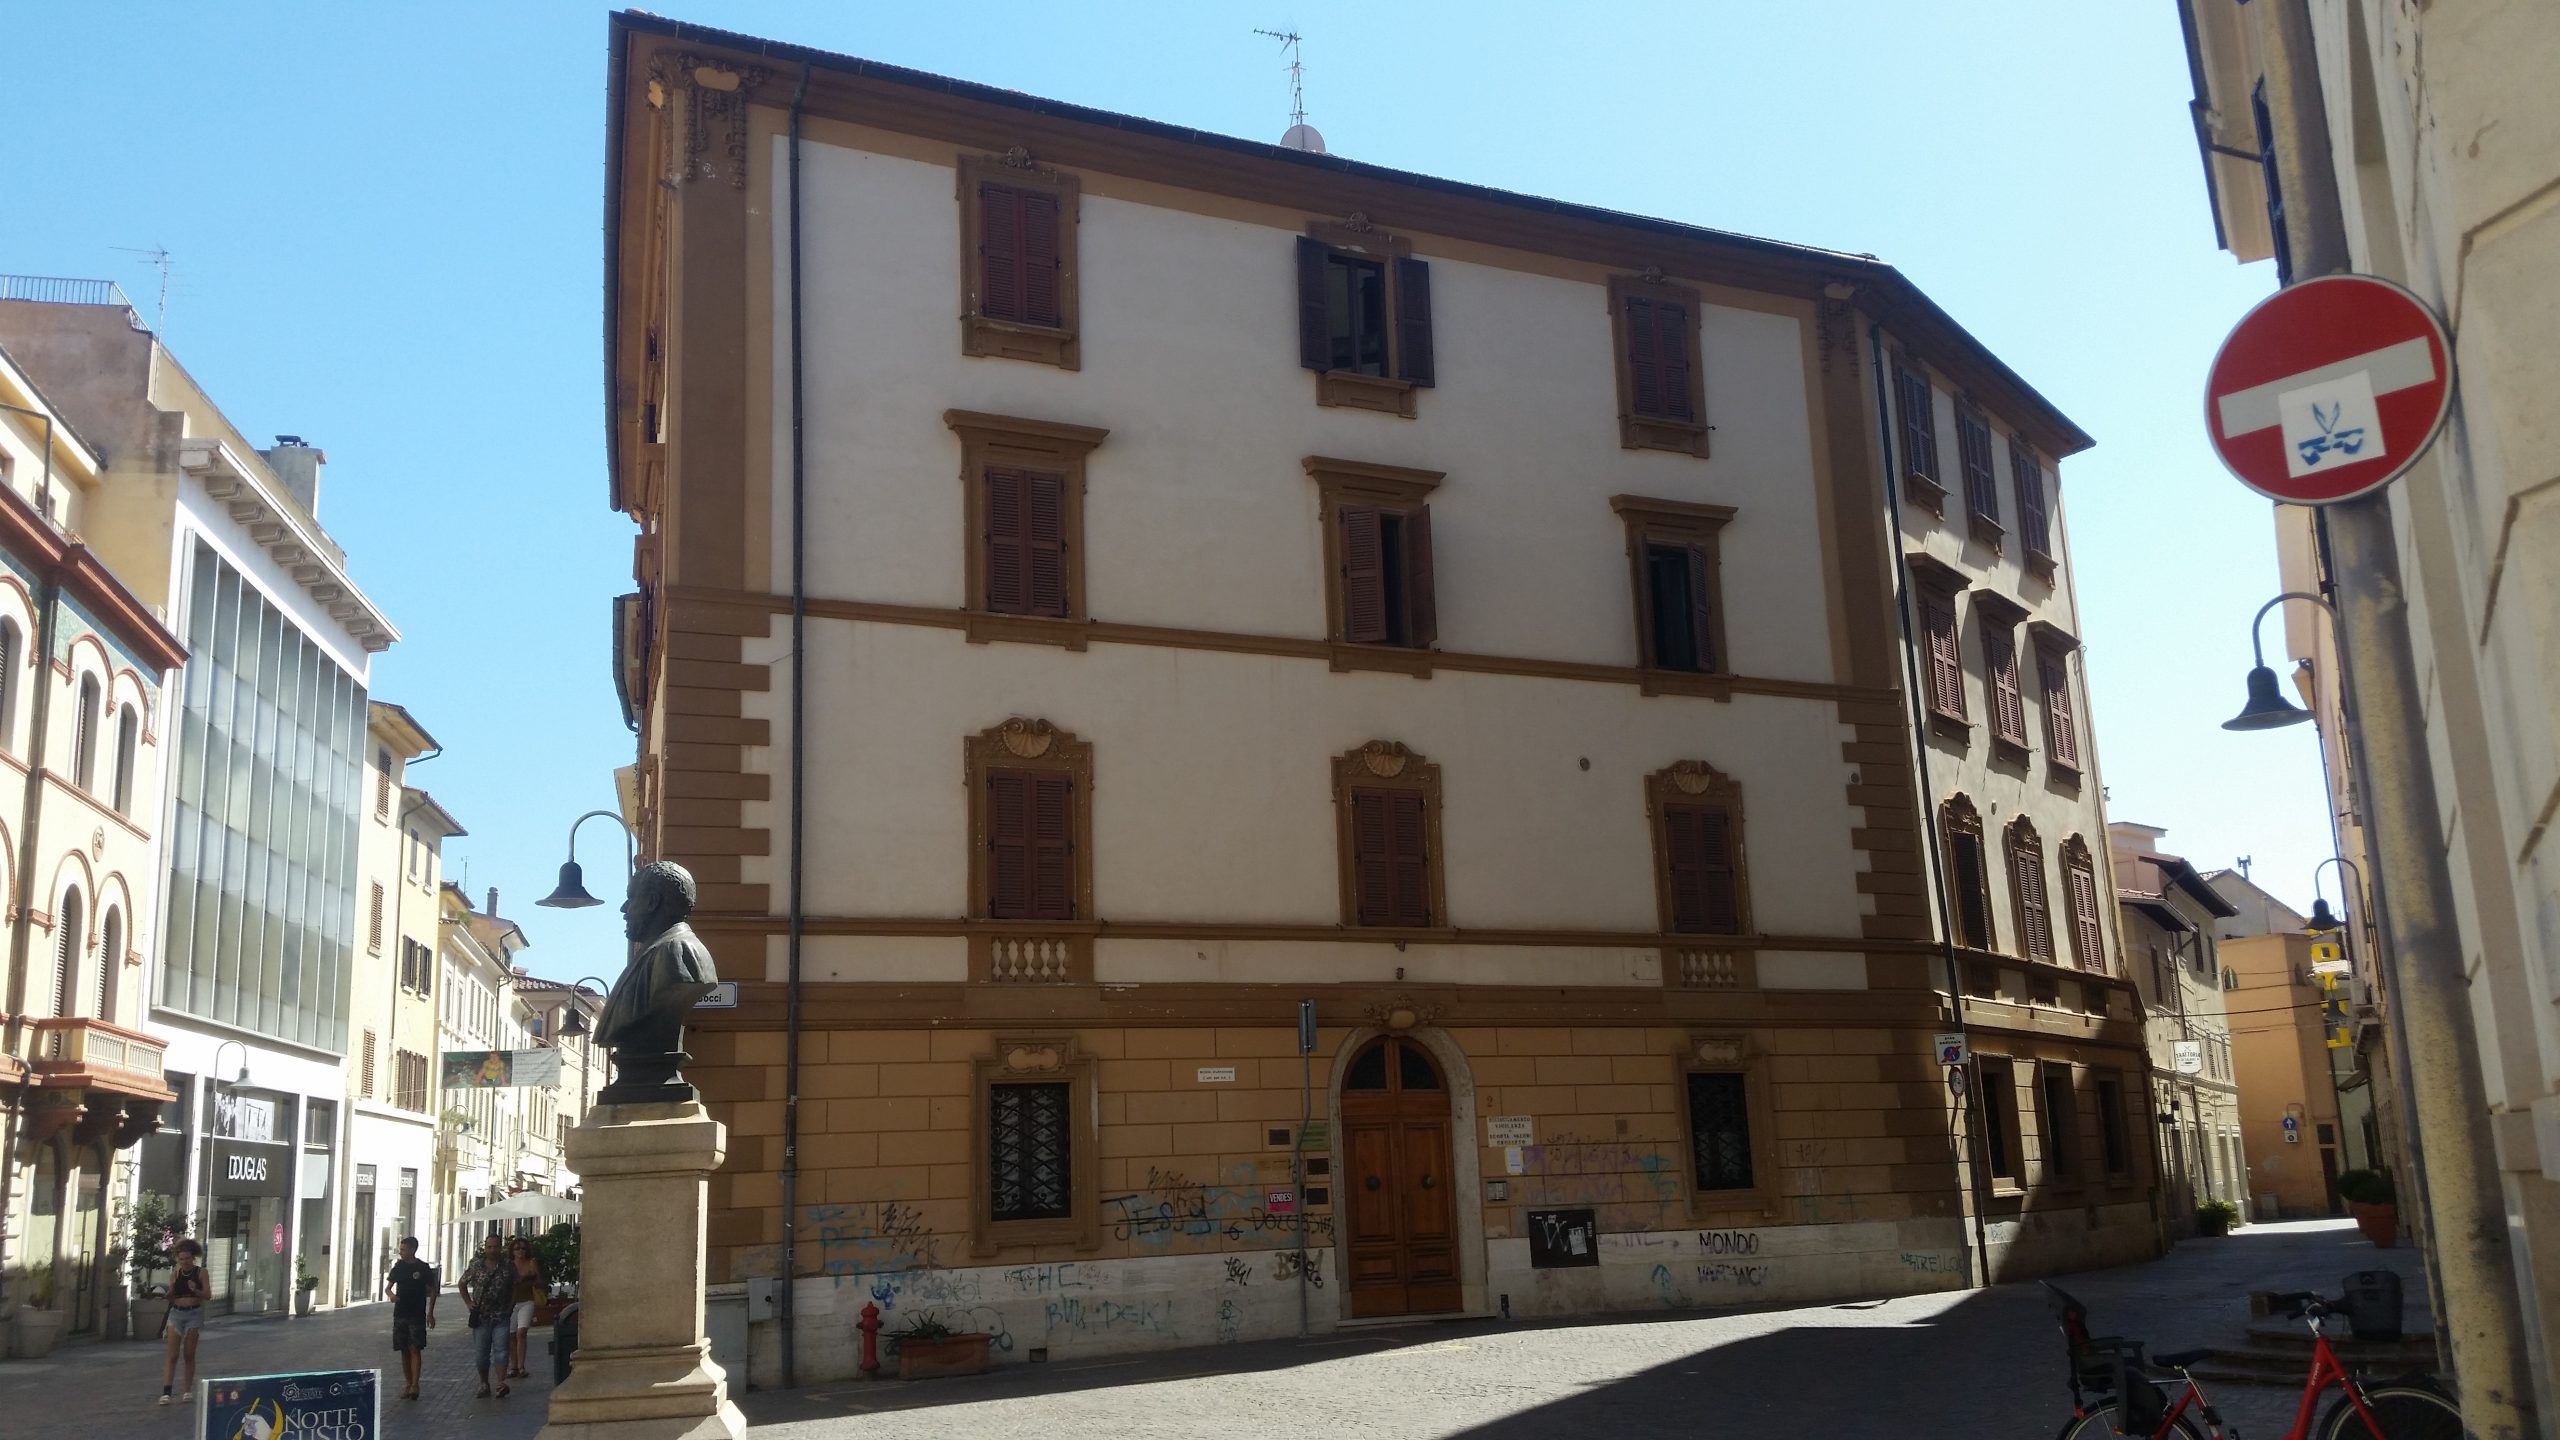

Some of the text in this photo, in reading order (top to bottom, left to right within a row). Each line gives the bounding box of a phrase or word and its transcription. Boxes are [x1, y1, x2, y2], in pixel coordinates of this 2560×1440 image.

[1487, 1095, 1494, 1108] 2
[228, 1155, 267, 1181] DOUGLAS
[1699, 1230, 1759, 1255] MONDO
[285, 1407, 358, 1430] NOTTE
